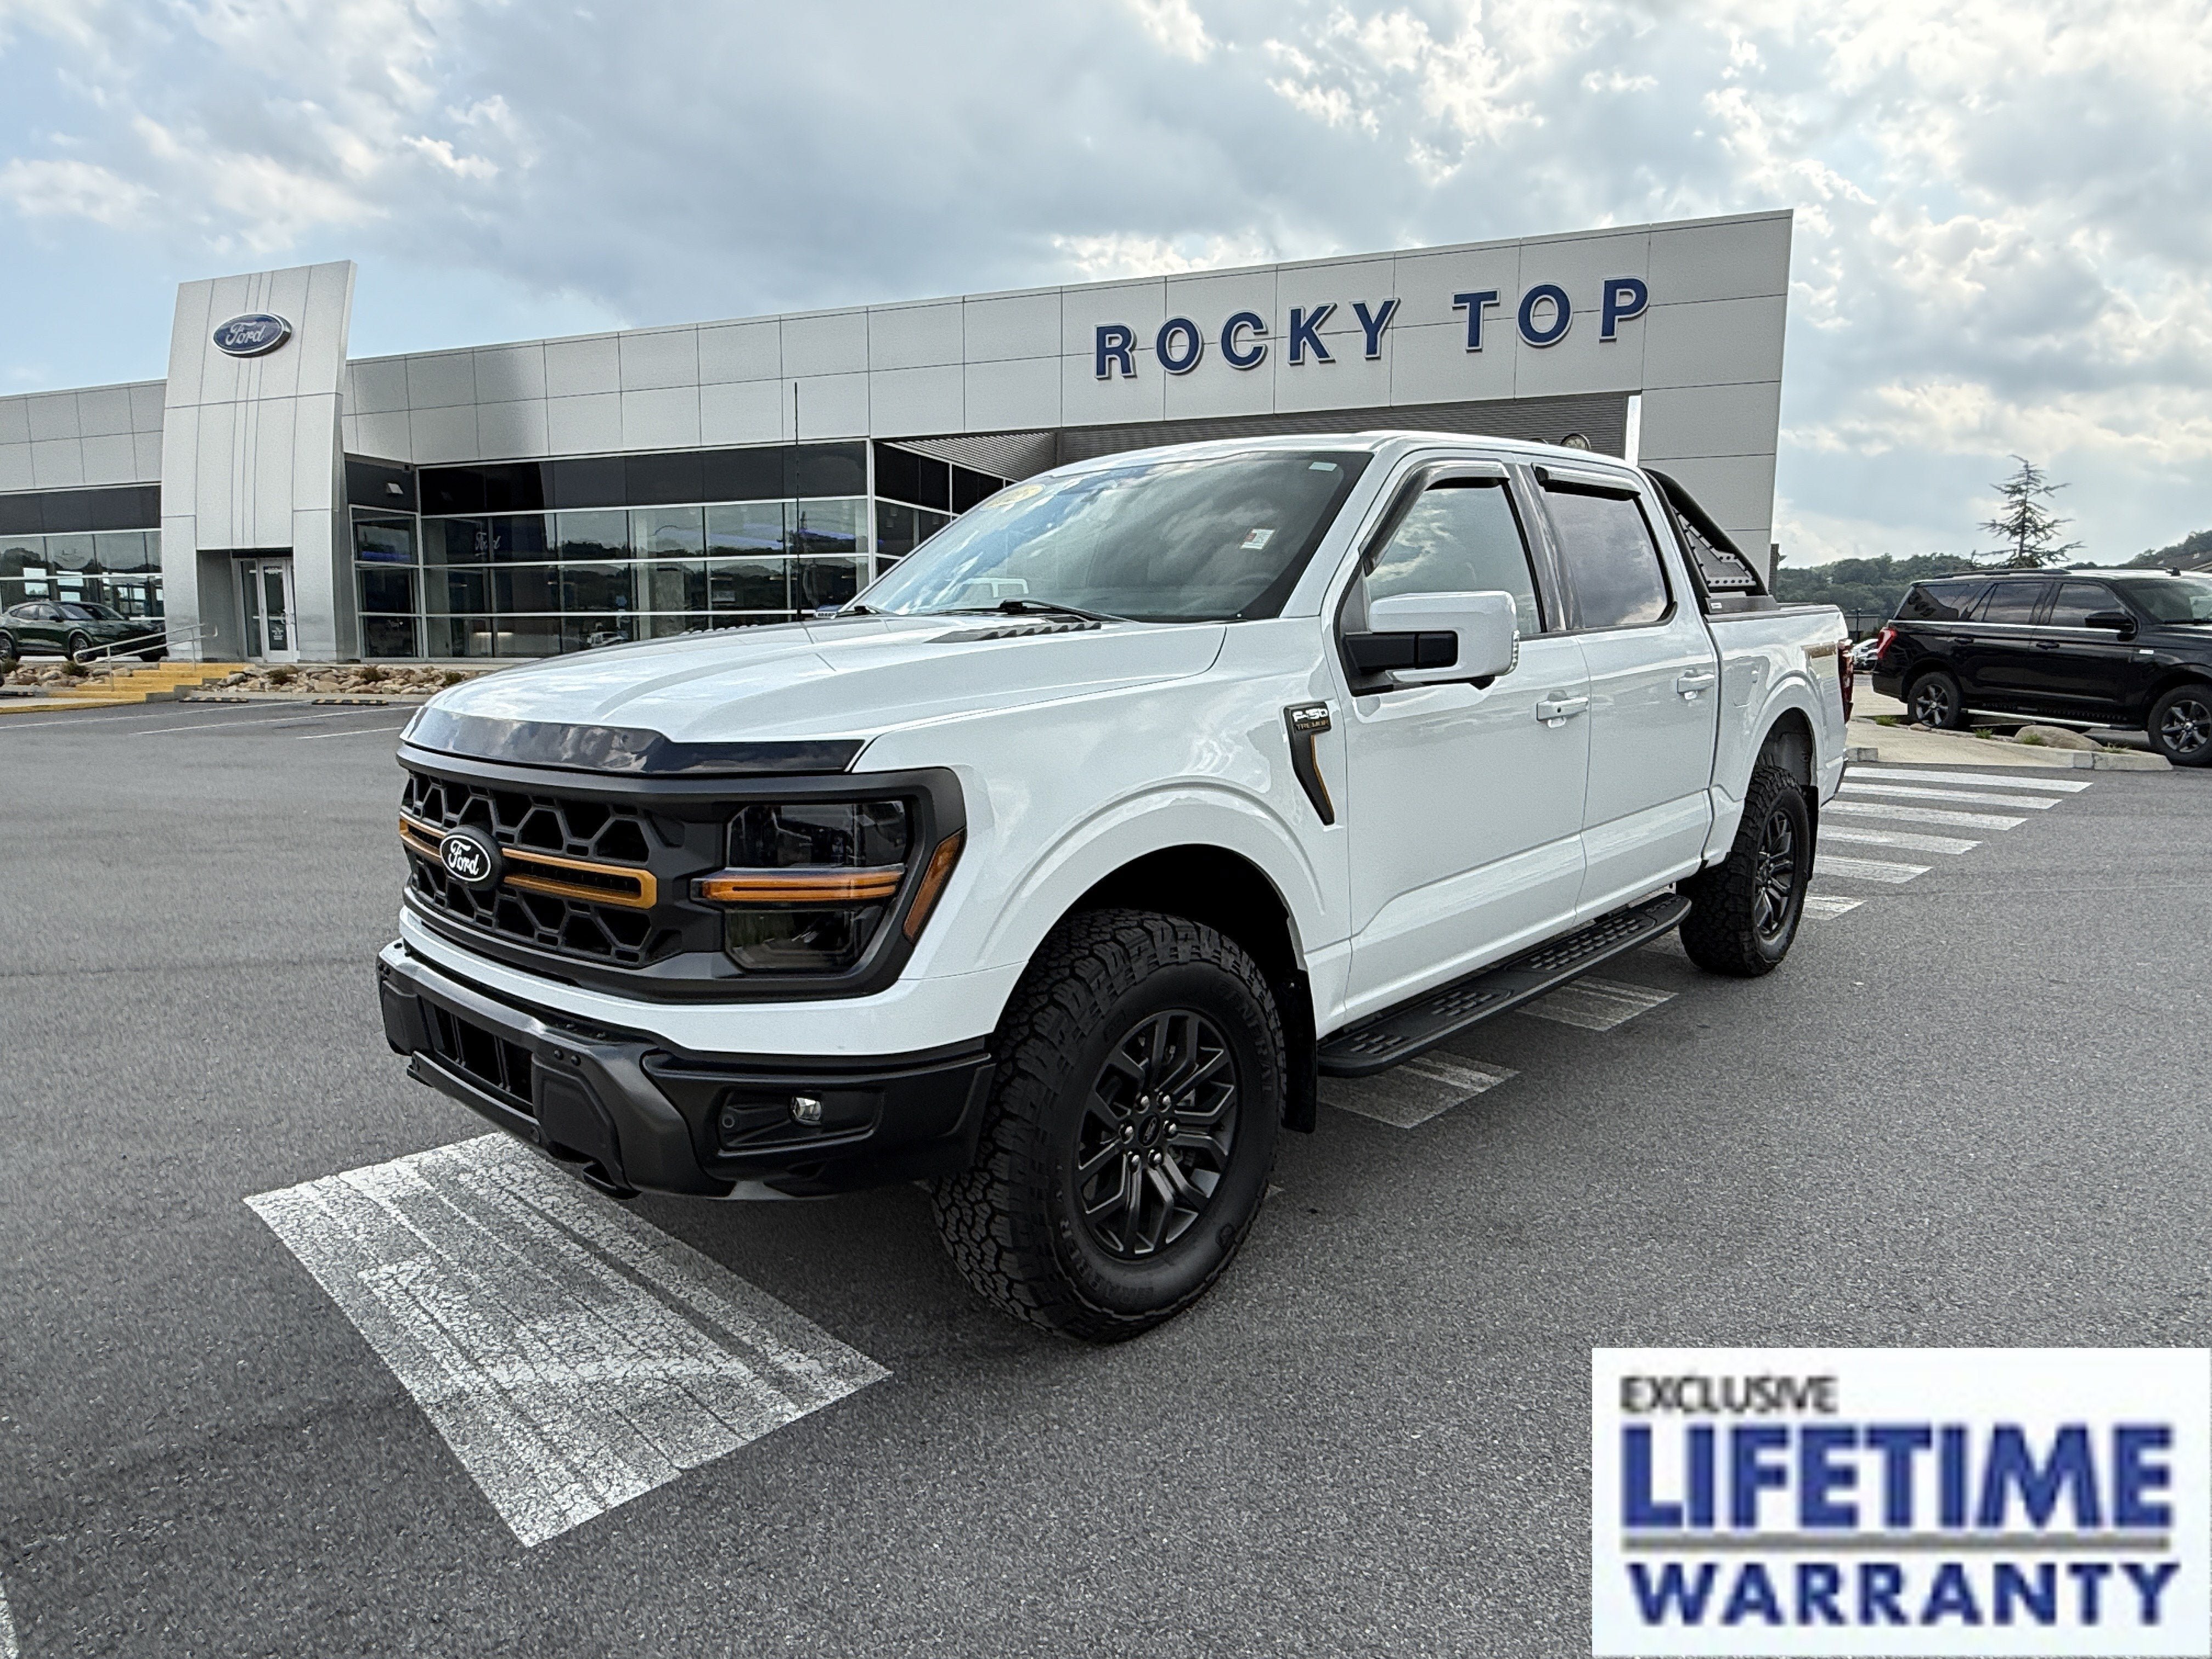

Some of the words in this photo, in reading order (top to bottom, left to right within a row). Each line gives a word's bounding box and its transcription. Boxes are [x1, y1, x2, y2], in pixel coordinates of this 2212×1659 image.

[225, 321, 267, 346] Ford
[1094, 297, 1398, 379] ROCKY
[1453, 276, 1649, 351] TOP
[448, 839, 479, 876] Ford
